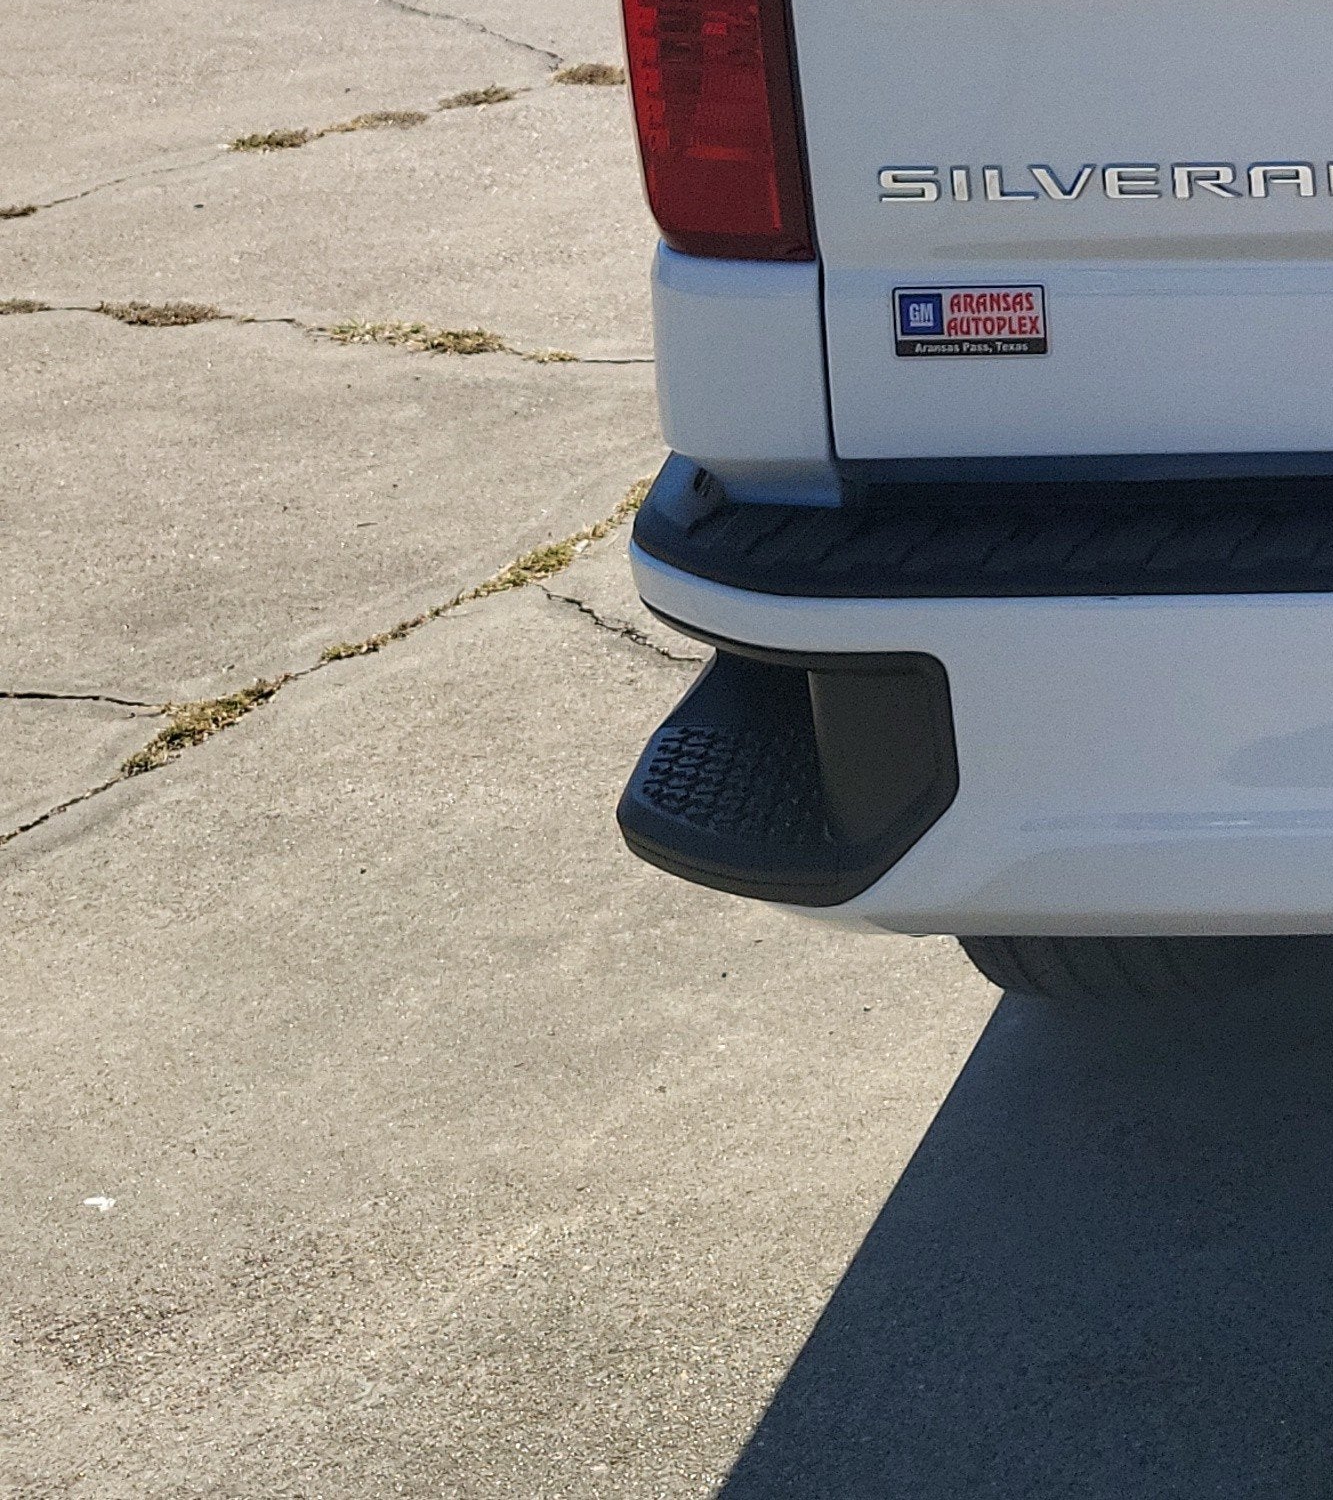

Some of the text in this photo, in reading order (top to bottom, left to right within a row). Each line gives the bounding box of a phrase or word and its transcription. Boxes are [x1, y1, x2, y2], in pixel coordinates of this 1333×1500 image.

[909, 303, 934, 322] GM
[950, 292, 1035, 314] ARANSAS
[946, 316, 1041, 337] AUTOPLEX
[915, 341, 1029, 354] Aransas Pass, Texas
